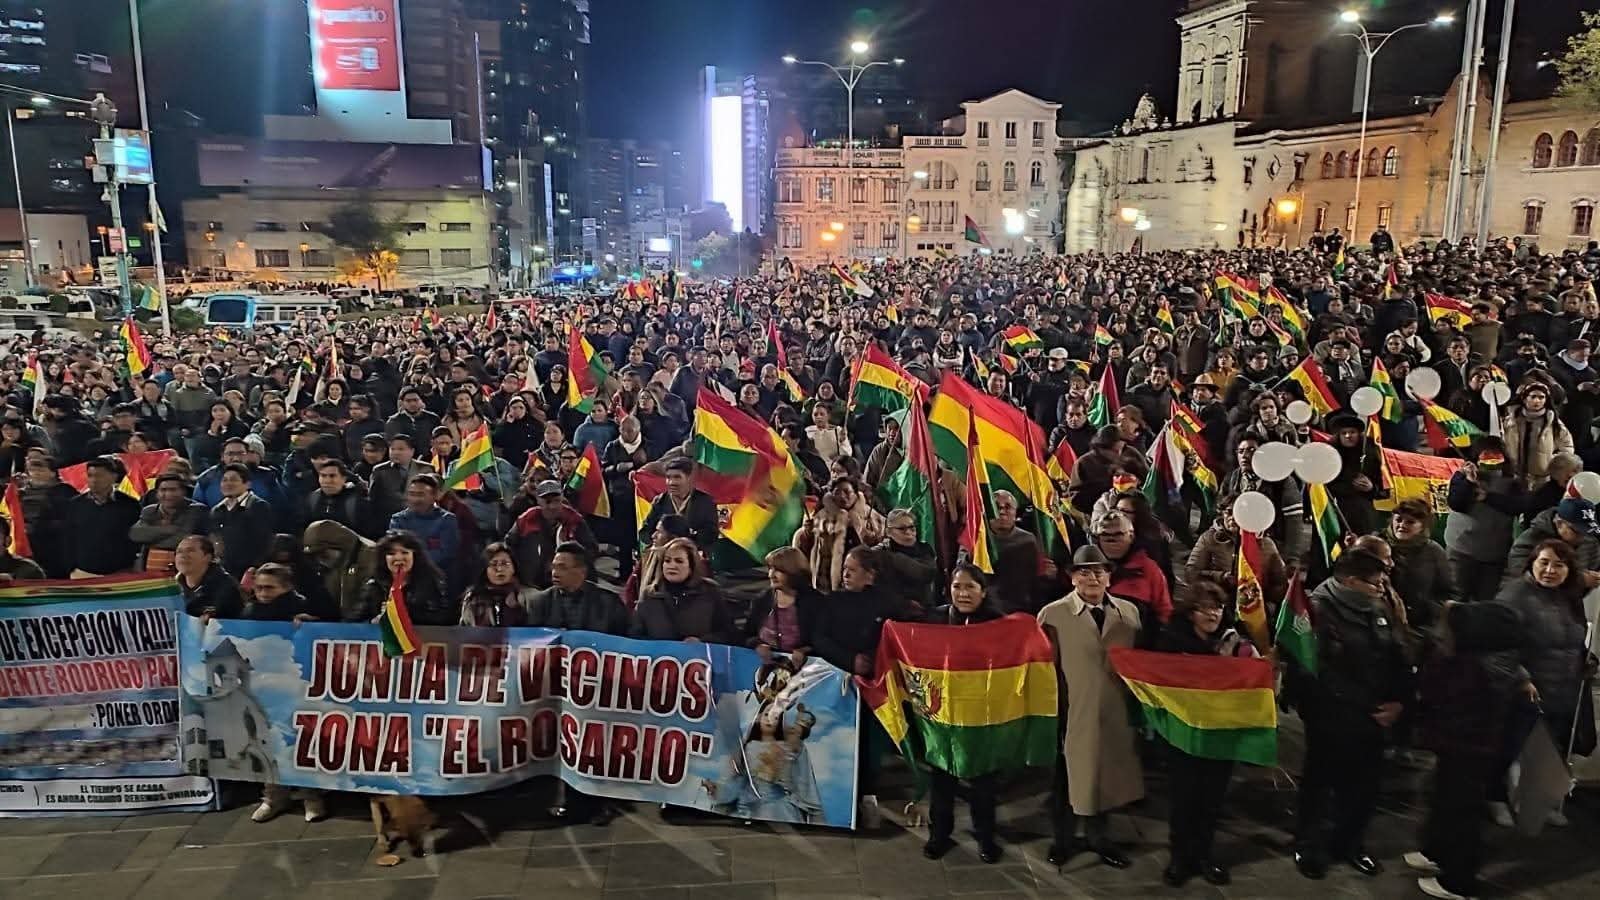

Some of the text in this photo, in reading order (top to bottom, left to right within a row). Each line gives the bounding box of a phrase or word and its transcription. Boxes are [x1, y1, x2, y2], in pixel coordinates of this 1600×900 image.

[18, 611, 129, 661] EXCEPCION
[124, 608, 176, 652] YA!!!
[54, 658, 144, 695] RODRIGO
[144, 656, 178, 689] PAZ
[307, 640, 711, 722] JUNTA DE VECINOS
[294, 708, 713, 787] ZONA "EL ROSARIO"
[124, 784, 134, 792] SE
